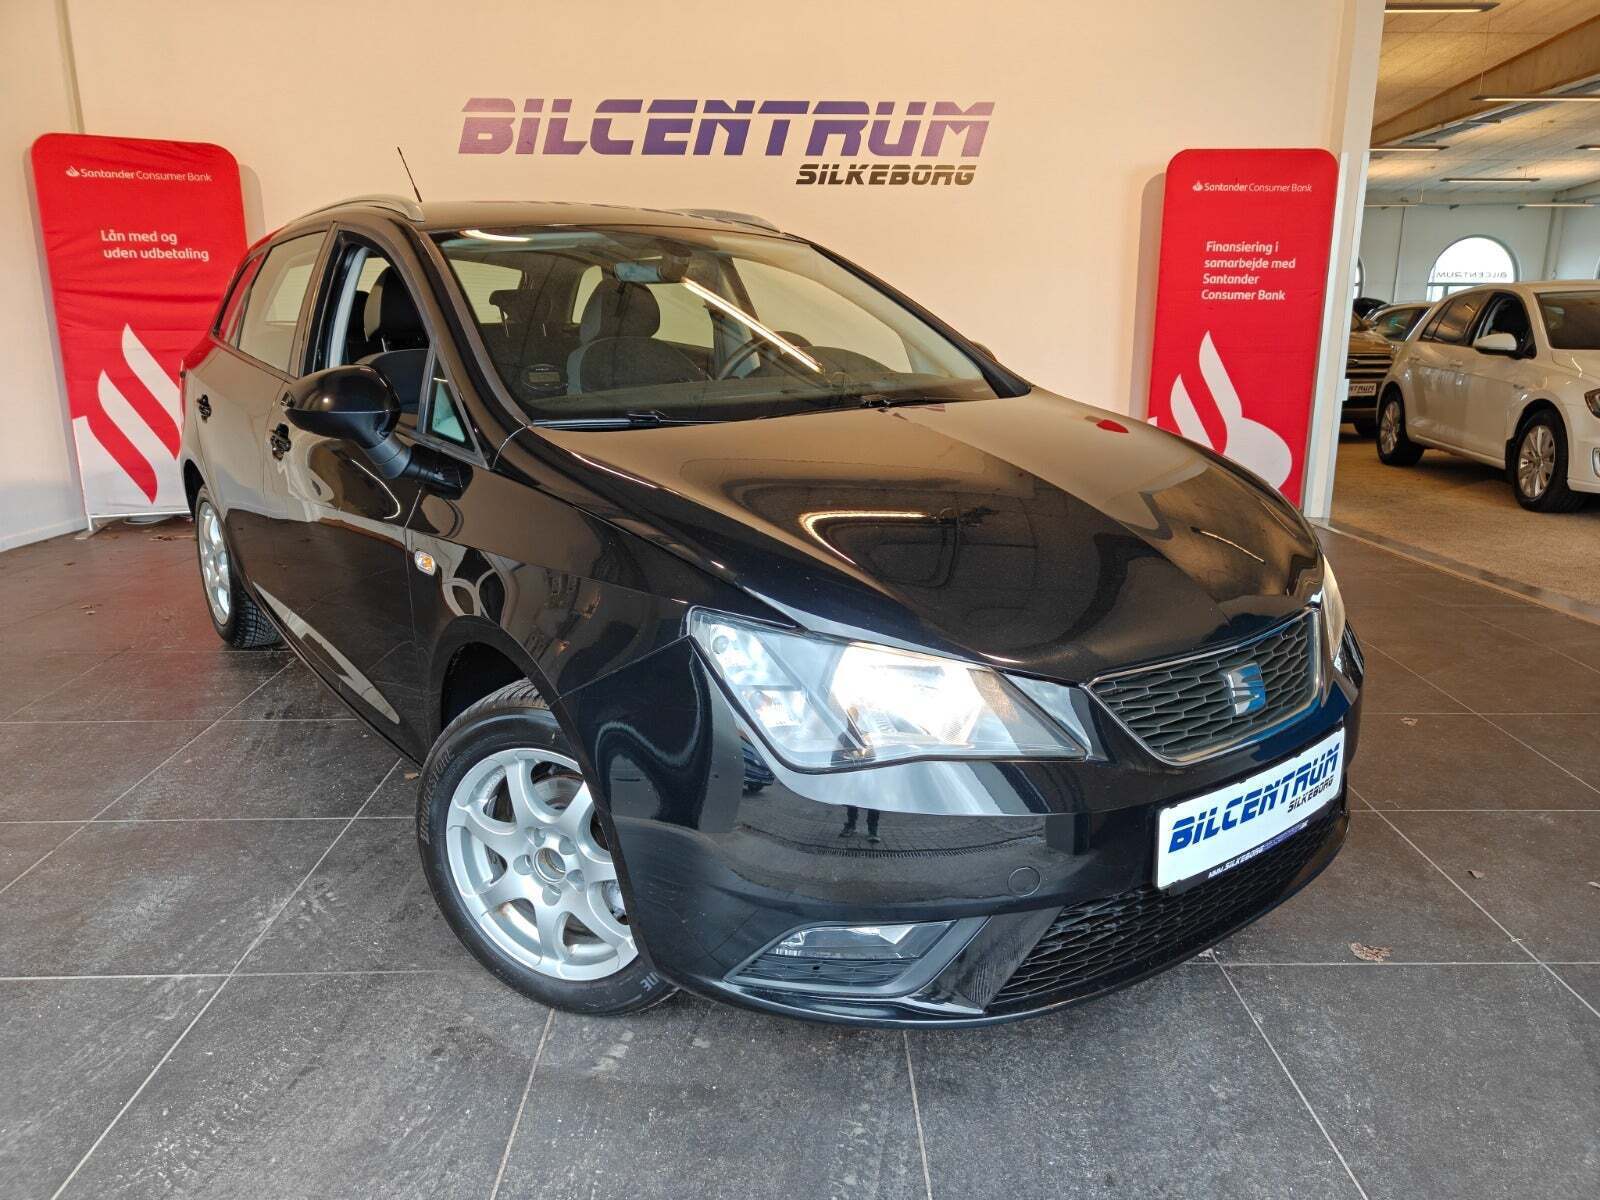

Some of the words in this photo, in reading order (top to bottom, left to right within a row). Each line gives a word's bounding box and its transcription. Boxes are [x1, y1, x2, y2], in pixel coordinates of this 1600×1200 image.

[458, 98, 995, 157] BILCENTRUM
[81, 168, 135, 180] Santander
[136, 171, 186, 182] Consumer
[187, 172, 213, 183] Bank
[795, 163, 977, 186] SILKEBORG
[1203, 182, 1248, 192] Santander
[1249, 183, 1290, 192] Consumer
[1291, 183, 1313, 192] Bank
[100, 230, 125, 242] Lån
[129, 231, 157, 242] med
[160, 233, 177, 246] og
[1206, 241, 1273, 254] Finansiering
[103, 248, 137, 259] uden
[140, 248, 209, 262] udbetaling
[1204, 258, 1269, 271] samarbejde
[1271, 258, 1296, 269] med
[1202, 273, 1260, 285] Santander
[1201, 289, 1256, 300] Consumer
[1258, 290, 1286, 301] Bank
[1168, 743, 1340, 853] BILCENTRUM
[1287, 774, 1334, 813] SILKEBORG
